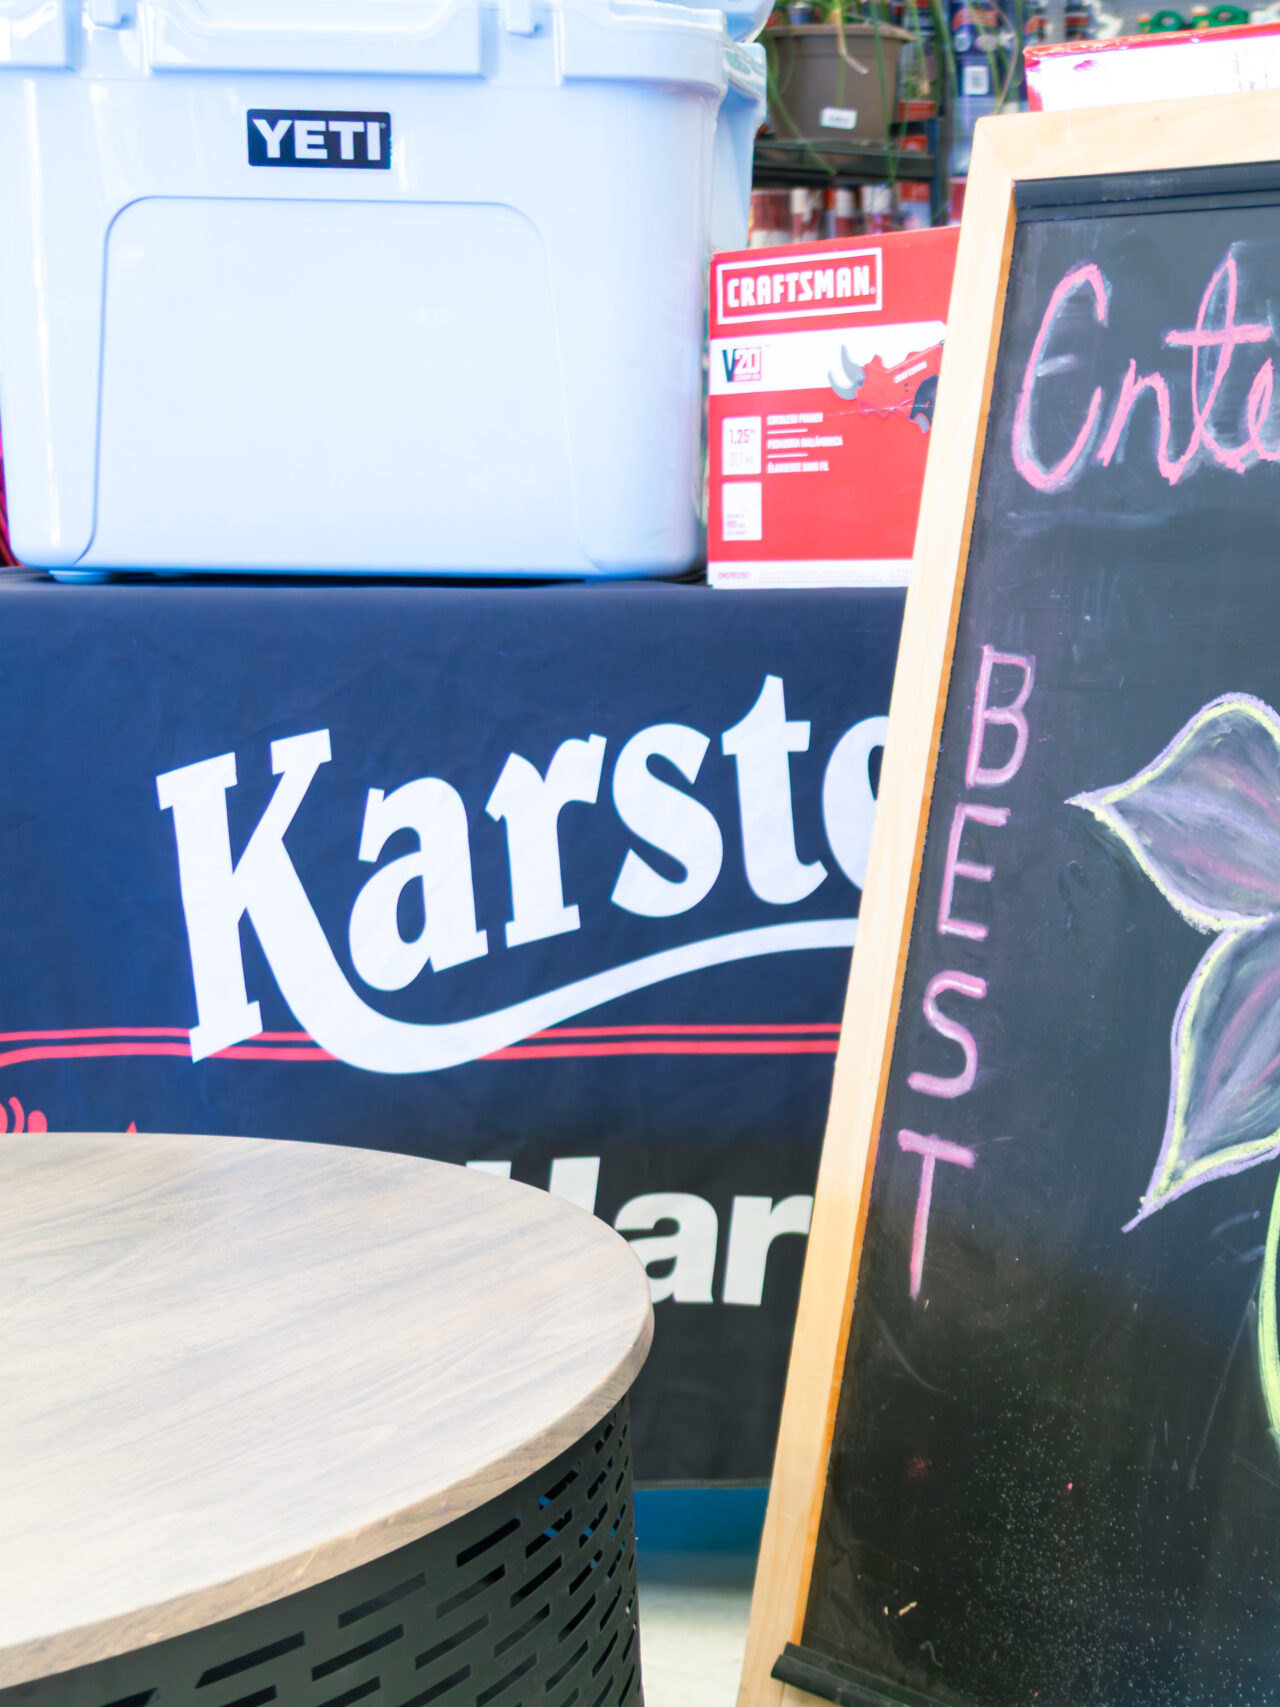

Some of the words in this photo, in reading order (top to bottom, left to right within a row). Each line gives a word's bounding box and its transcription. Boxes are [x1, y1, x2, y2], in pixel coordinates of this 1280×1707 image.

[252, 118, 382, 161] YETI
[726, 264, 871, 308] CRAFTSMAN
[721, 348, 763, 384] V20
[898, 644, 1036, 1302] BEST
